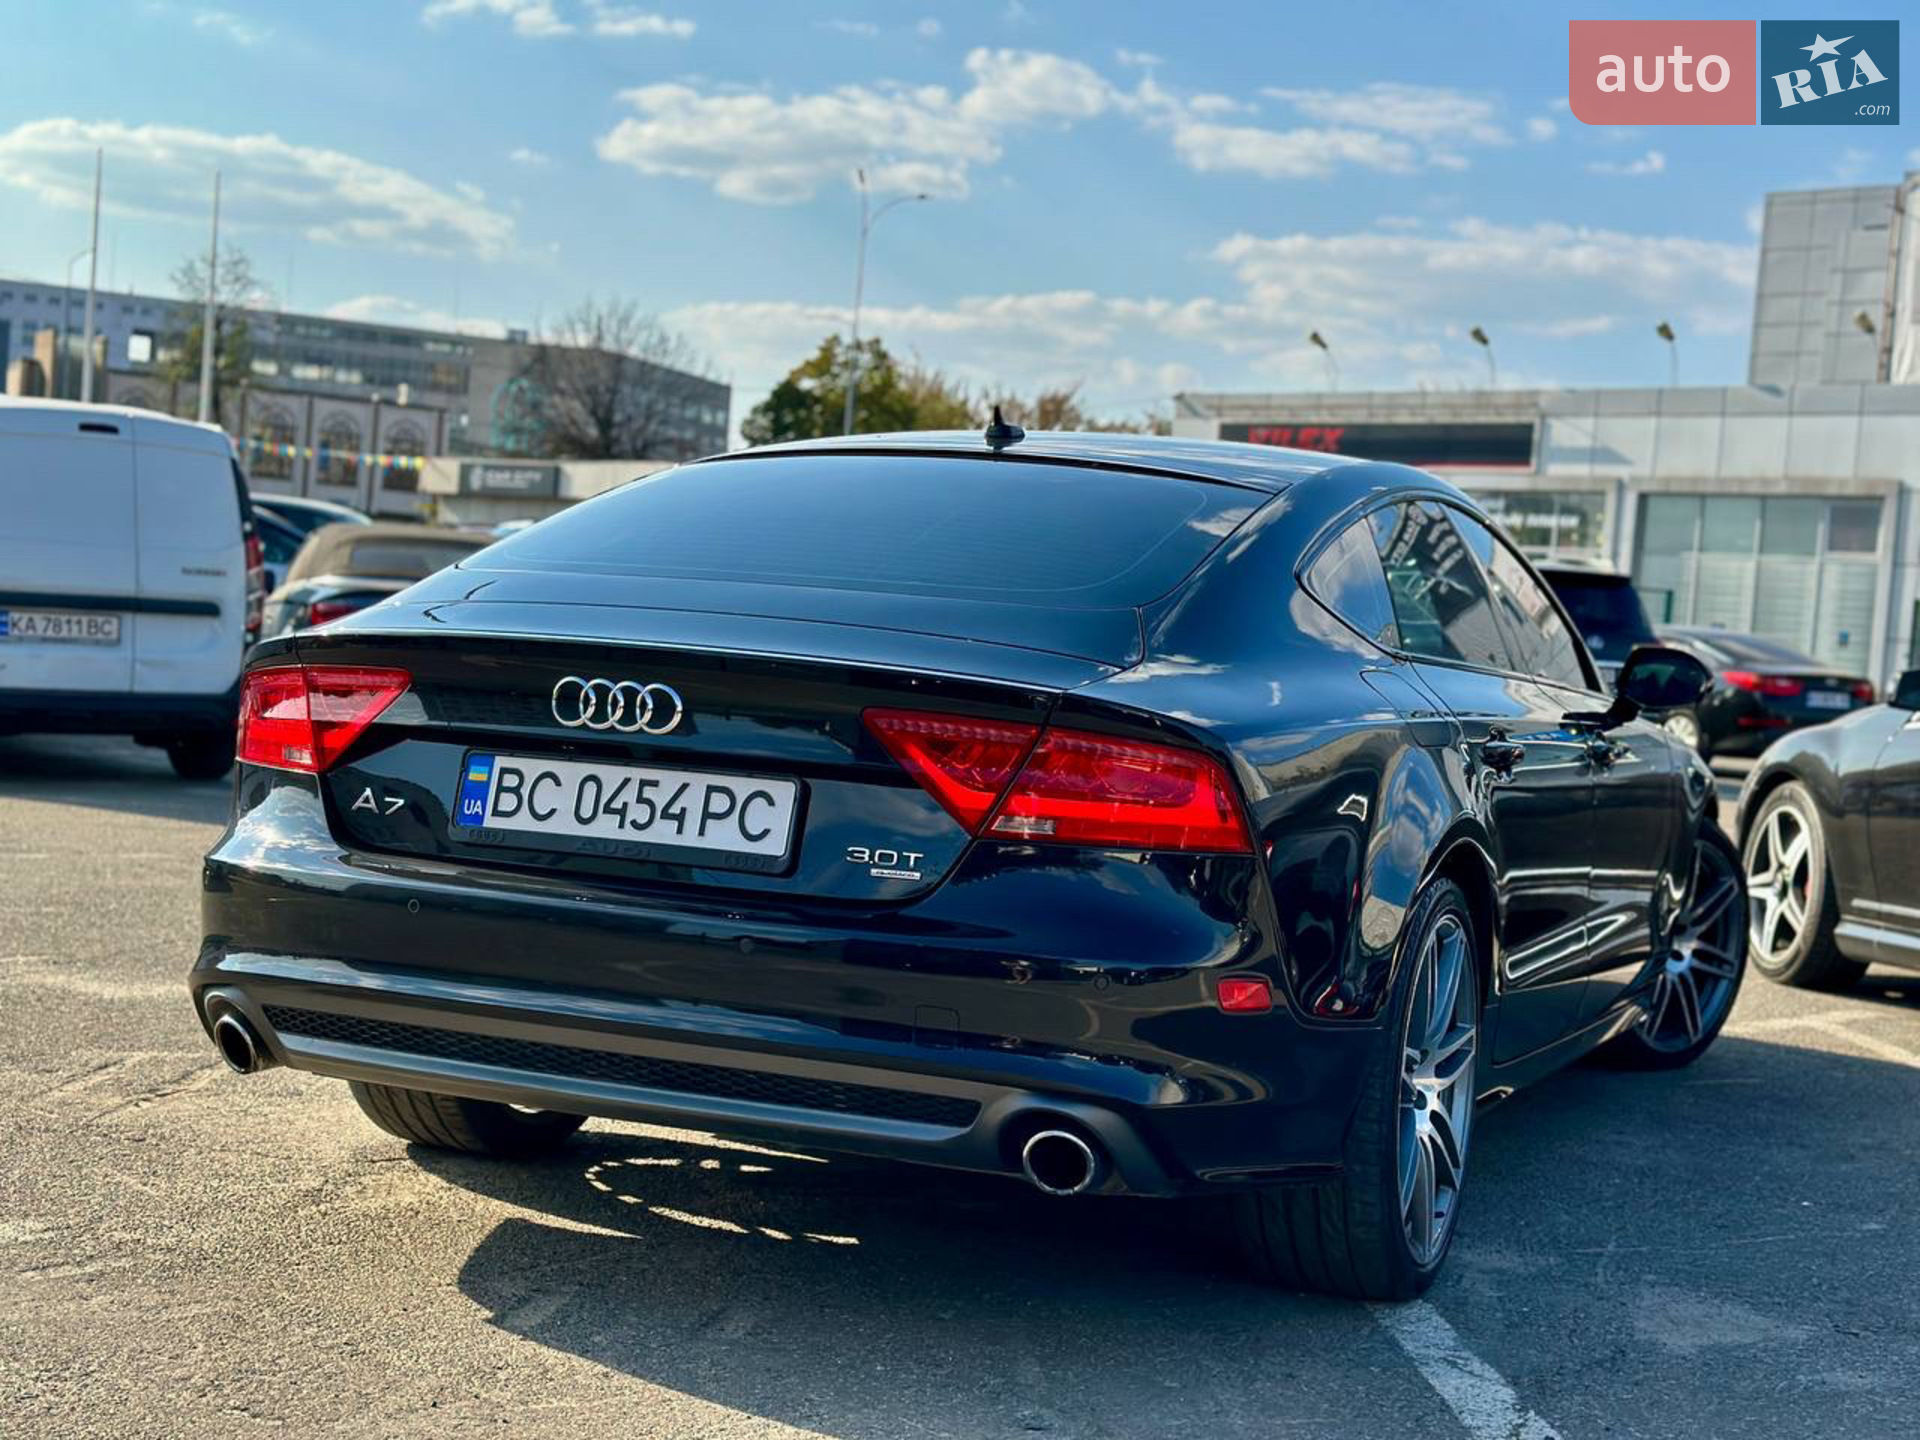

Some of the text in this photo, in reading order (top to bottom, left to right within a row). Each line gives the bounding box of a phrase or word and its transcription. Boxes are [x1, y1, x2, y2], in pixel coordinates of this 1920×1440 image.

[10, 616, 113, 636] KA 7811 BC
[351, 786, 406, 816] A7
[464, 798, 483, 816] UA
[490, 766, 776, 843] BC 0454 PC
